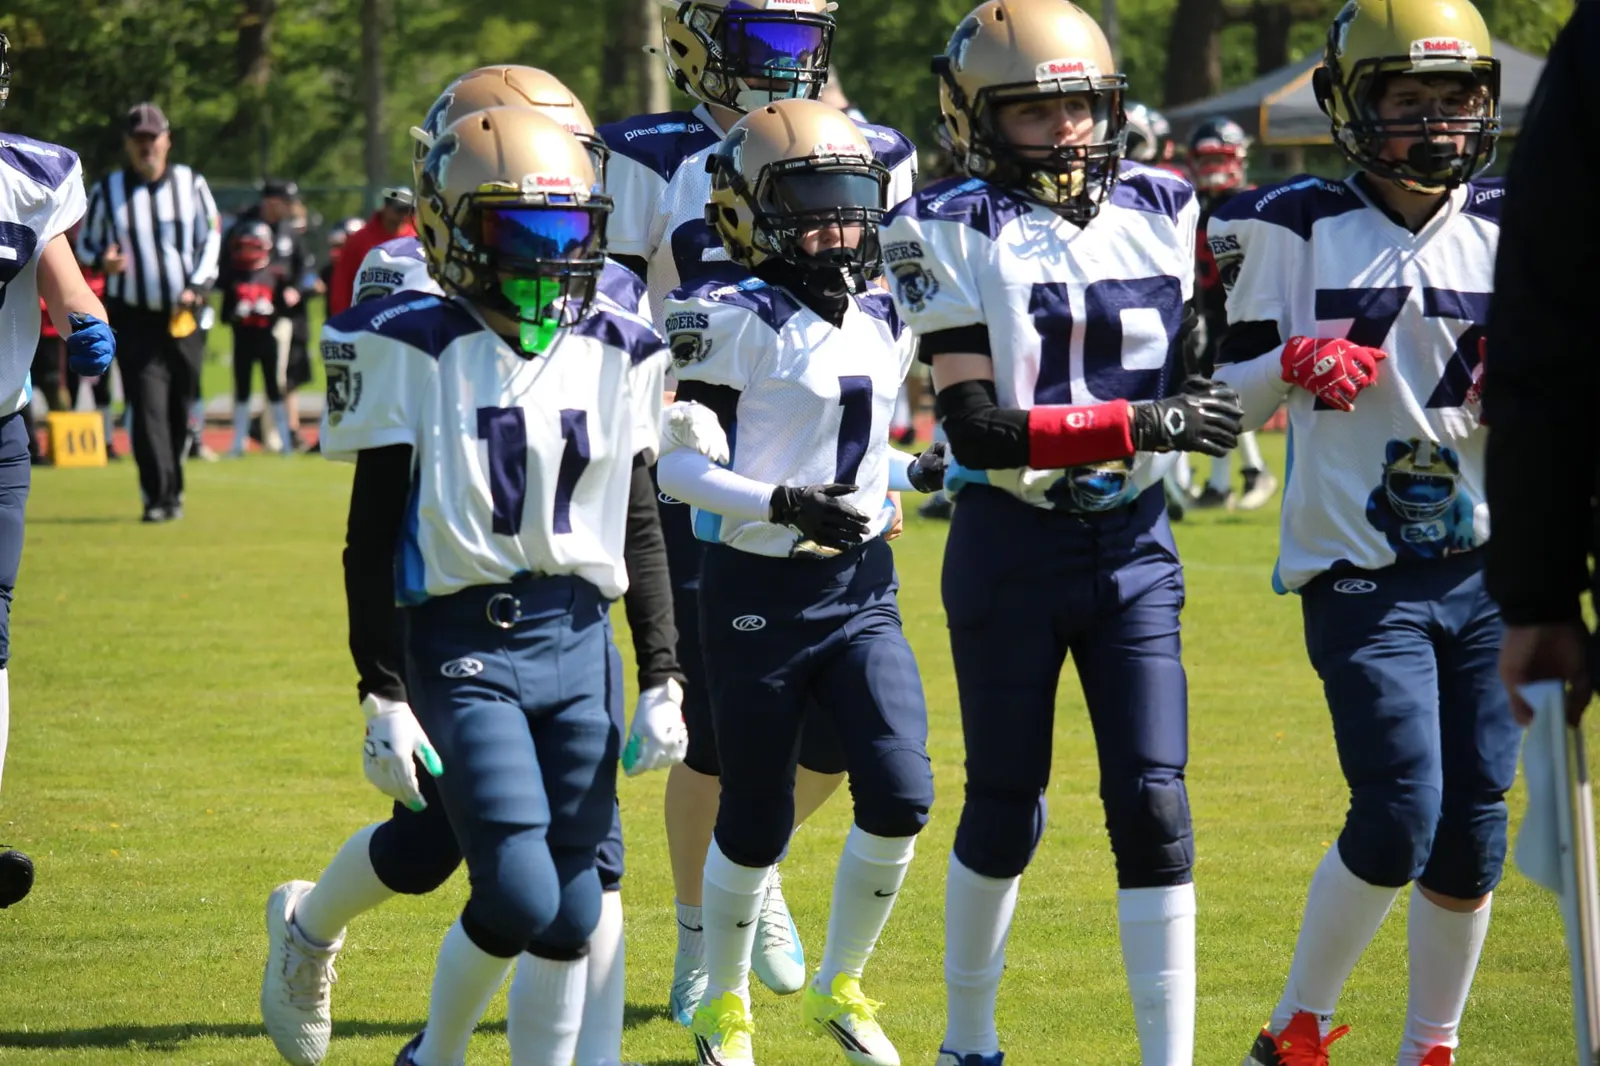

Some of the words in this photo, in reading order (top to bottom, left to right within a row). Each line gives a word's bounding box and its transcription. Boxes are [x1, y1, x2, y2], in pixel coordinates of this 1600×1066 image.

[1049, 62, 1084, 74] Riddell
[1424, 41, 1460, 51] Riddell
[536, 176, 571, 187] Riddell
[1475, 188, 1505, 204] prei
[1028, 274, 1184, 405] 10
[1313, 286, 1493, 411] 77
[834, 375, 873, 486] 1
[476, 406, 591, 537] 11
